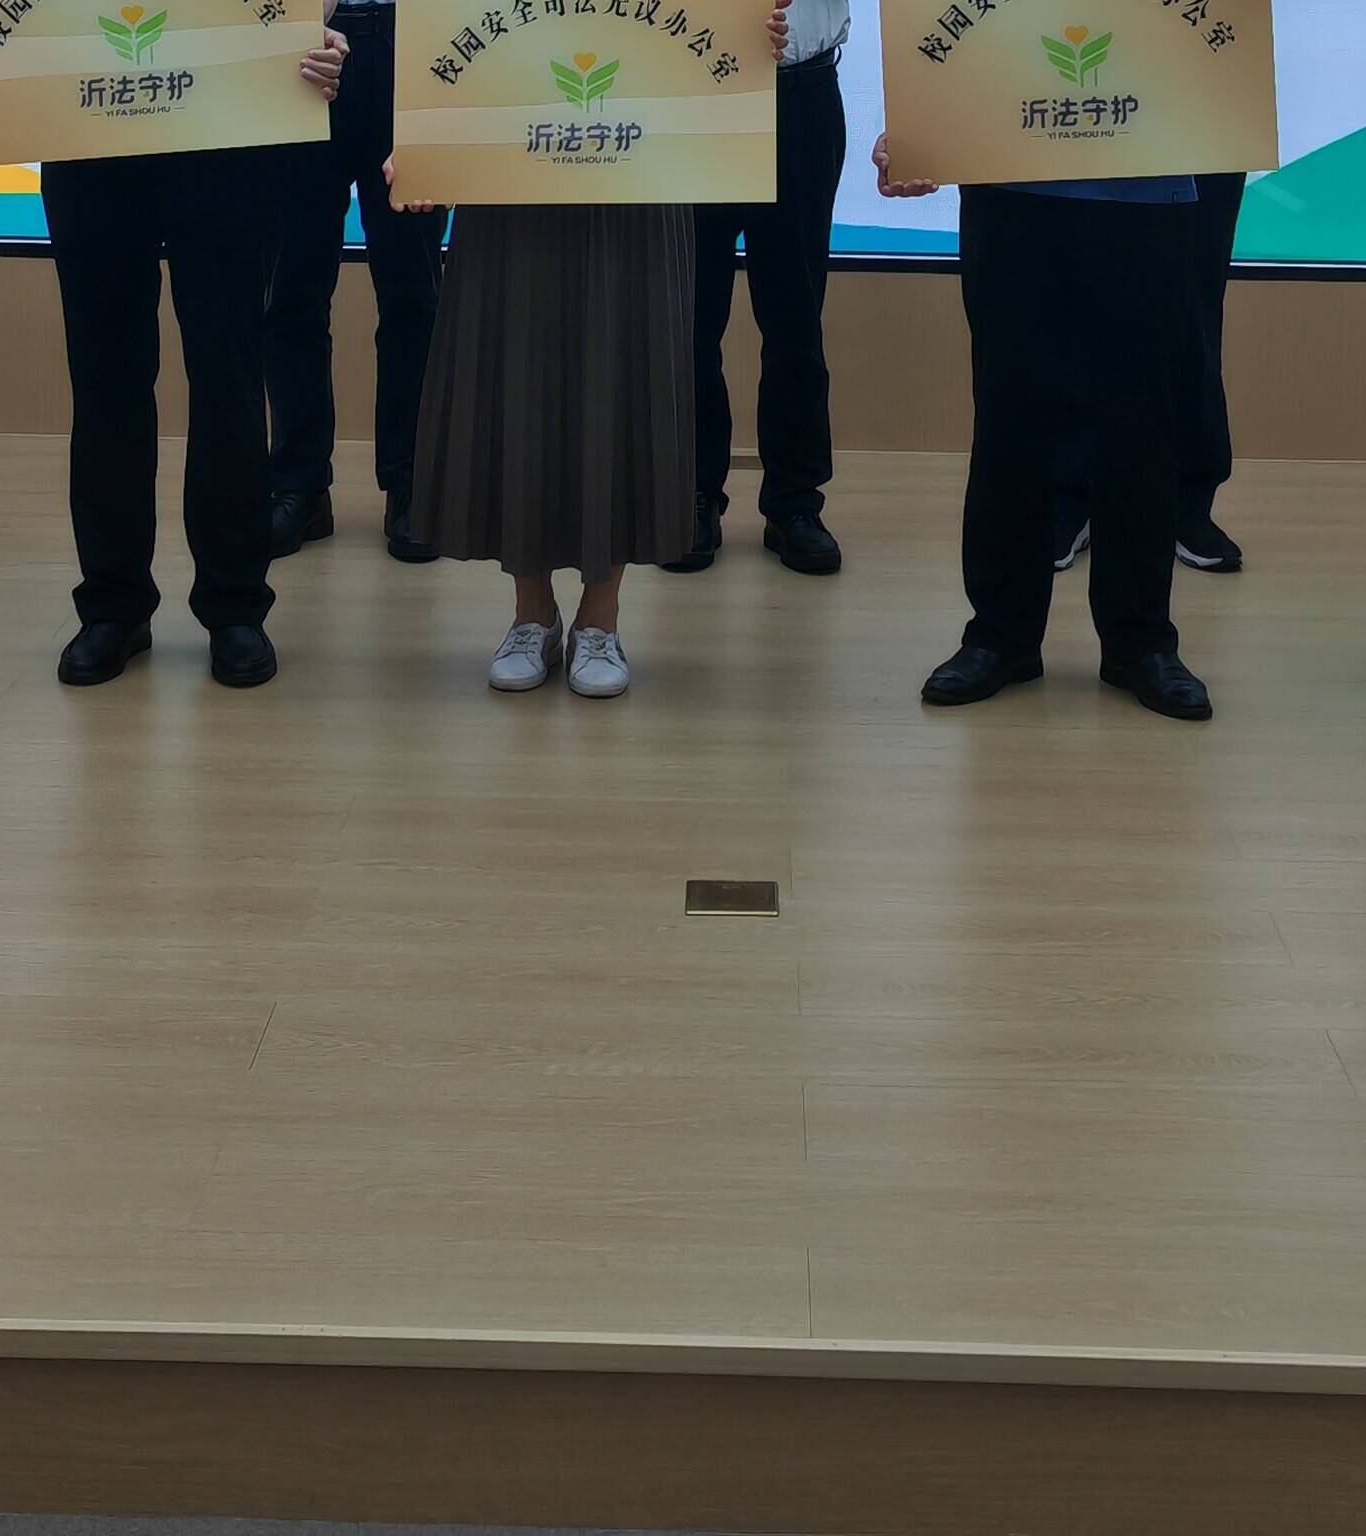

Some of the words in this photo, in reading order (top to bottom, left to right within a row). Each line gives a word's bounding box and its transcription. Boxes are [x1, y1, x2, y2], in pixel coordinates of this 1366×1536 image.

[79, 70, 194, 109] 沂法守护
[1021, 94, 1139, 129] 沂法守护
[526, 122, 642, 153] 沂法守护
